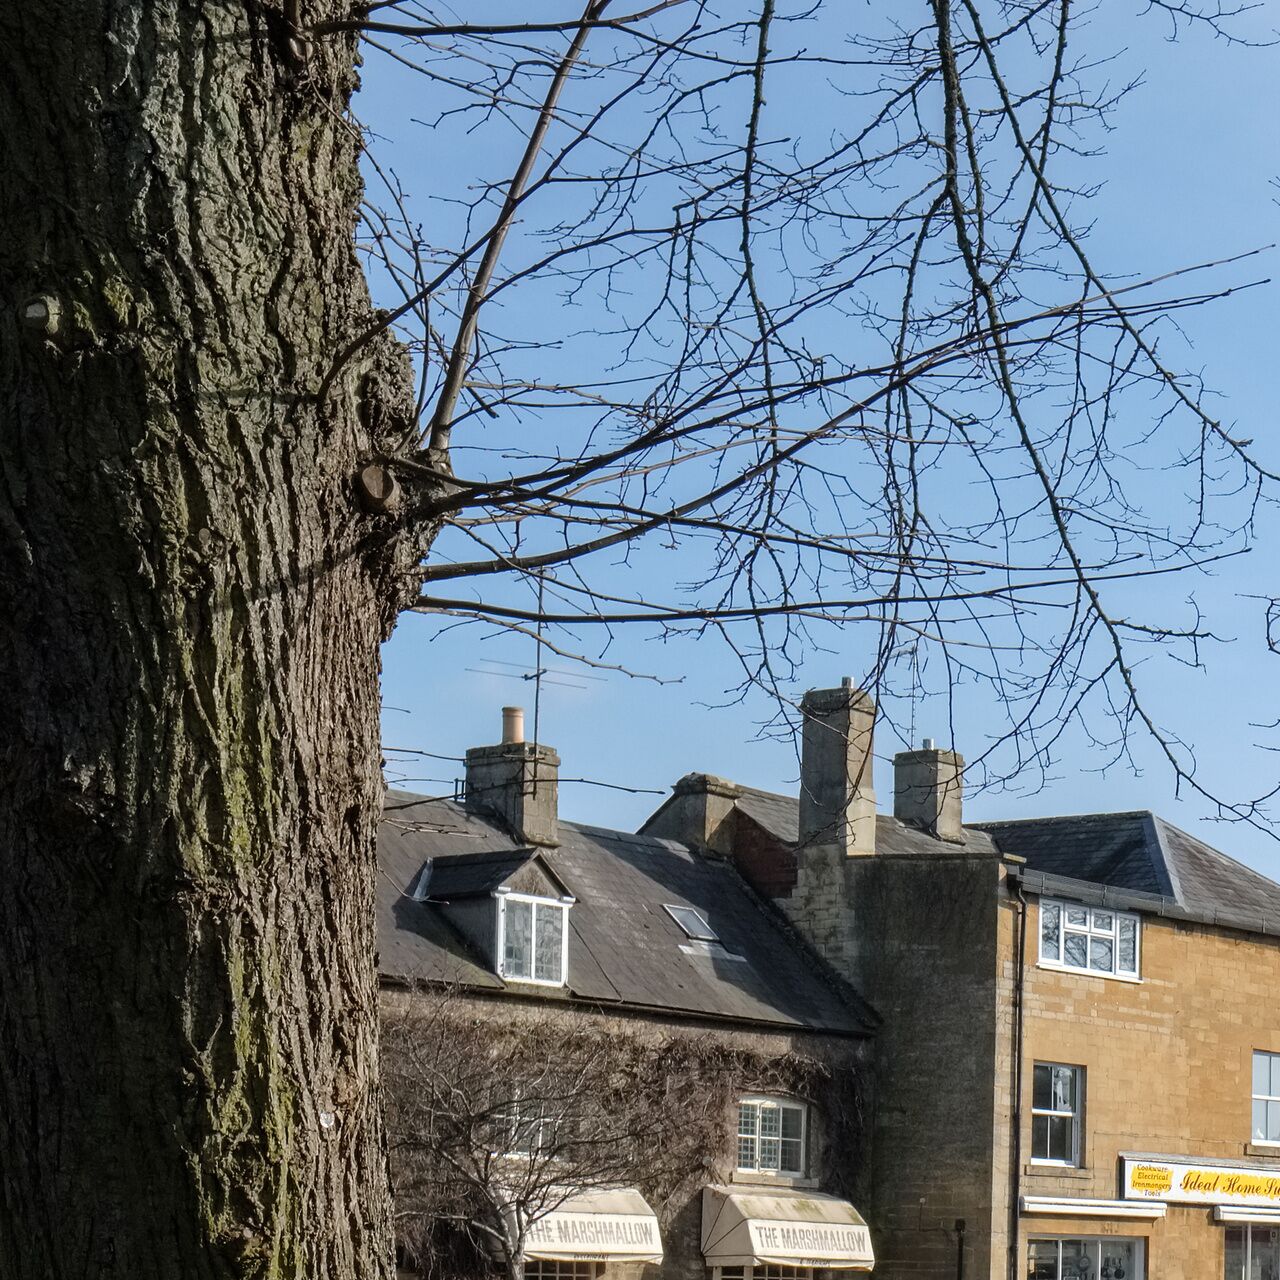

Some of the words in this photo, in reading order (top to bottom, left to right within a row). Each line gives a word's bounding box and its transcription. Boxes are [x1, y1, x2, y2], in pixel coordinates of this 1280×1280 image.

[1137, 1172, 1169, 1181] Electrical
[1180, 1172, 1219, 1192] Ideal
[1223, 1177, 1261, 1194] Home
[1132, 1180, 1173, 1192] Ironmongery
[1144, 1189, 1161, 1198] Tools
[557, 1220, 654, 1246] MARSHMALLOW
[755, 1226, 780, 1250] THE
[781, 1228, 867, 1253] MARSHMALLOW
